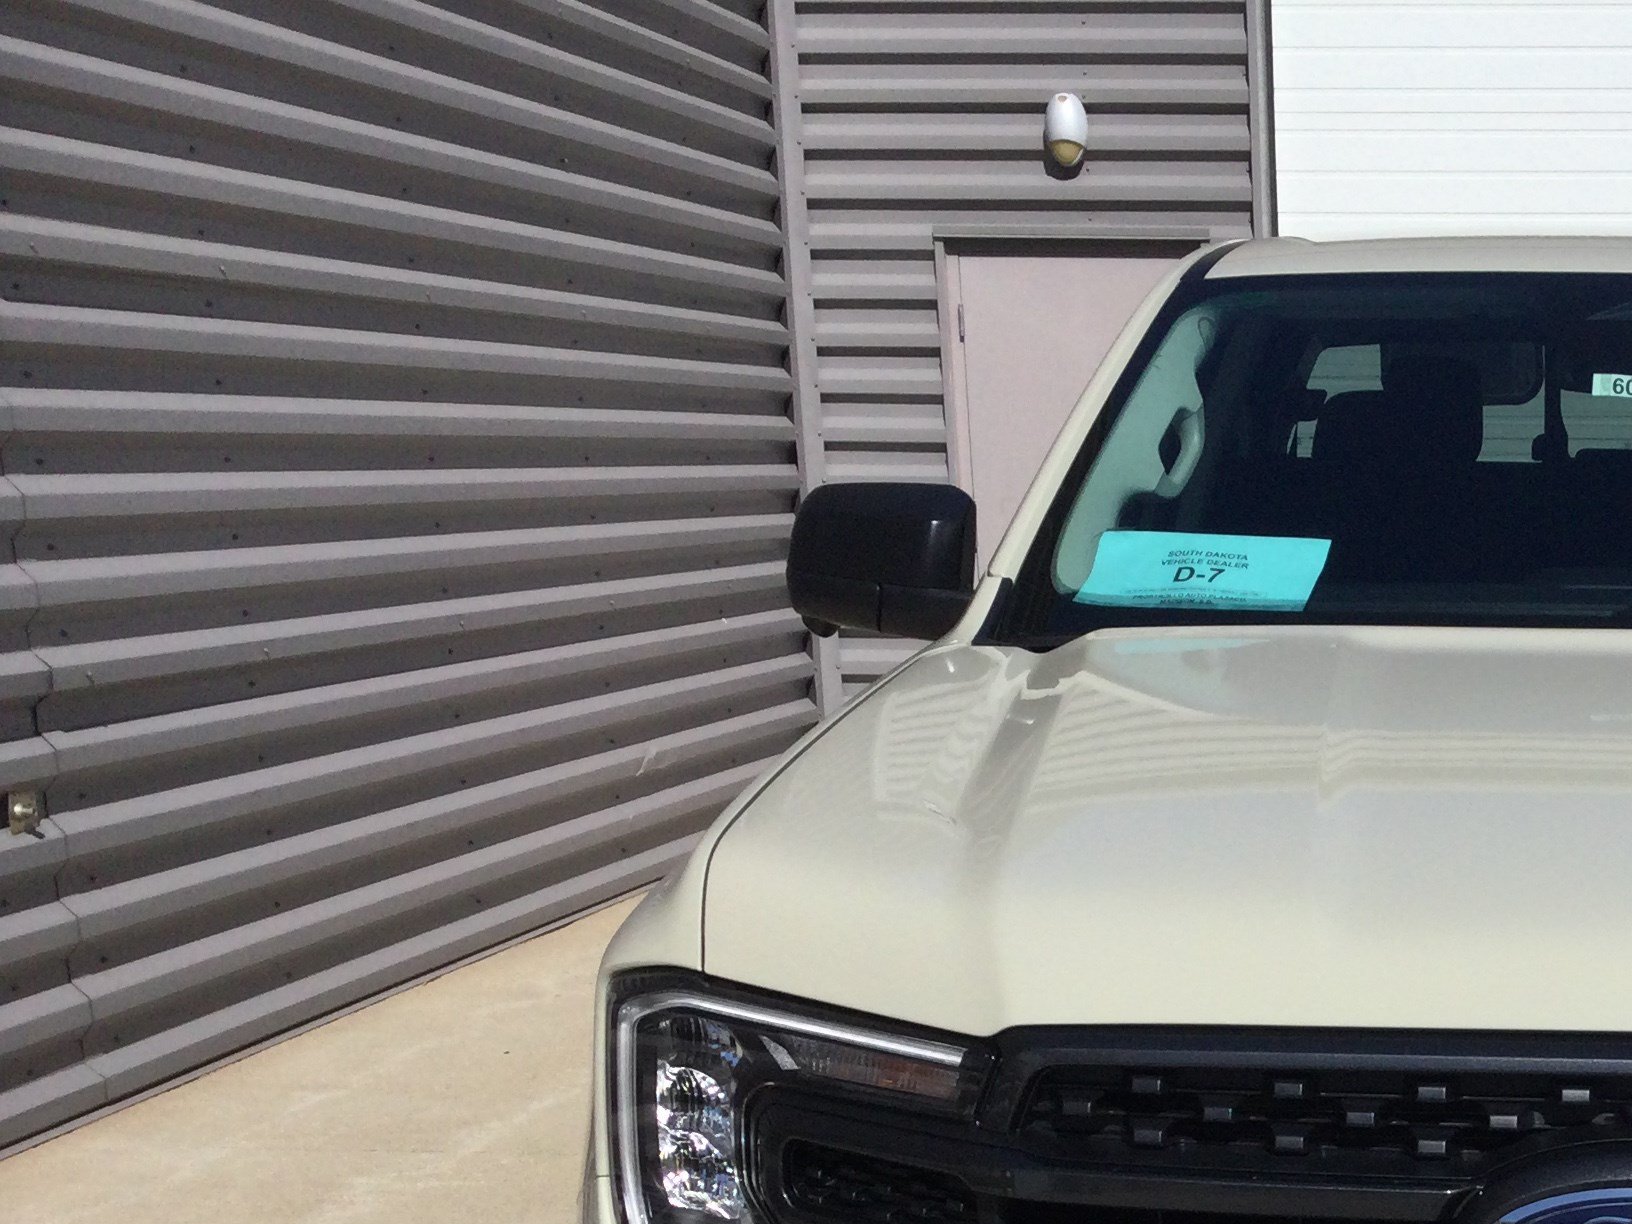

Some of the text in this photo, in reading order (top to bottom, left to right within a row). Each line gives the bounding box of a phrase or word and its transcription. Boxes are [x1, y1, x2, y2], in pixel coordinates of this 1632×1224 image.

[1167, 550, 1248, 560] SOUTH DAKOTA
[1161, 558, 1250, 569] VEHICLE DEALER
[1172, 566, 1226, 583] D-7
